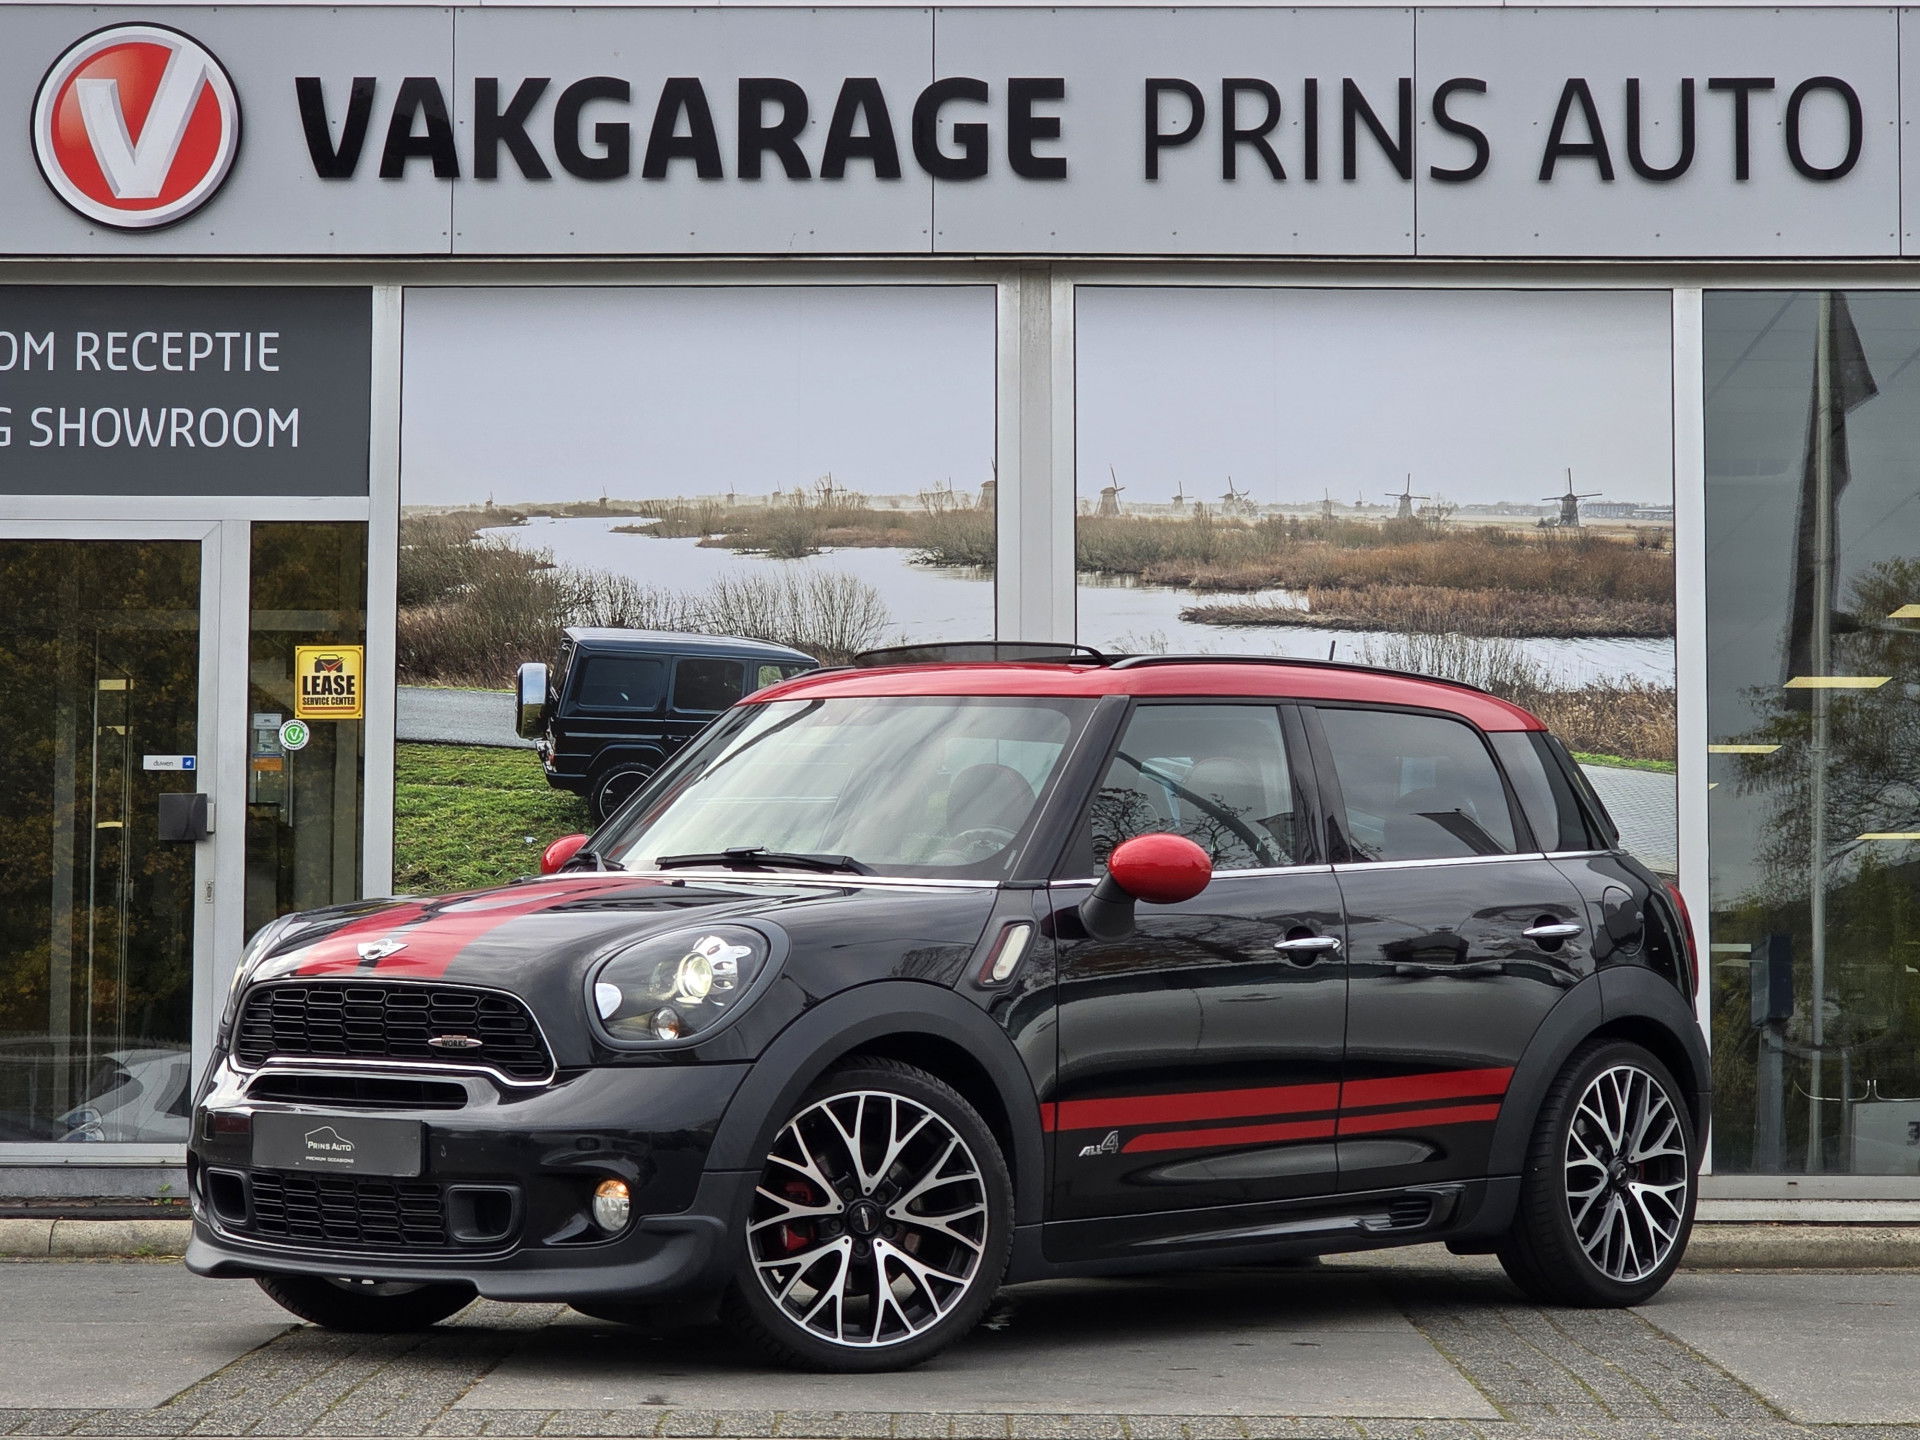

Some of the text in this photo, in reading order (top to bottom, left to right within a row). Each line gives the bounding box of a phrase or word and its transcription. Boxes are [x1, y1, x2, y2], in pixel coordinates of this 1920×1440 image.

[76, 43, 211, 199] V
[295, 77, 1864, 182] VAKGARAGE PRINS AUTO
[76, 332, 281, 372] RECEPTIE
[29, 407, 300, 448] SHOWROOM
[302, 675, 355, 695] LEASE
[302, 697, 355, 705] SERVICE CENTER
[308, 1141, 351, 1151] PRINS AUTO
